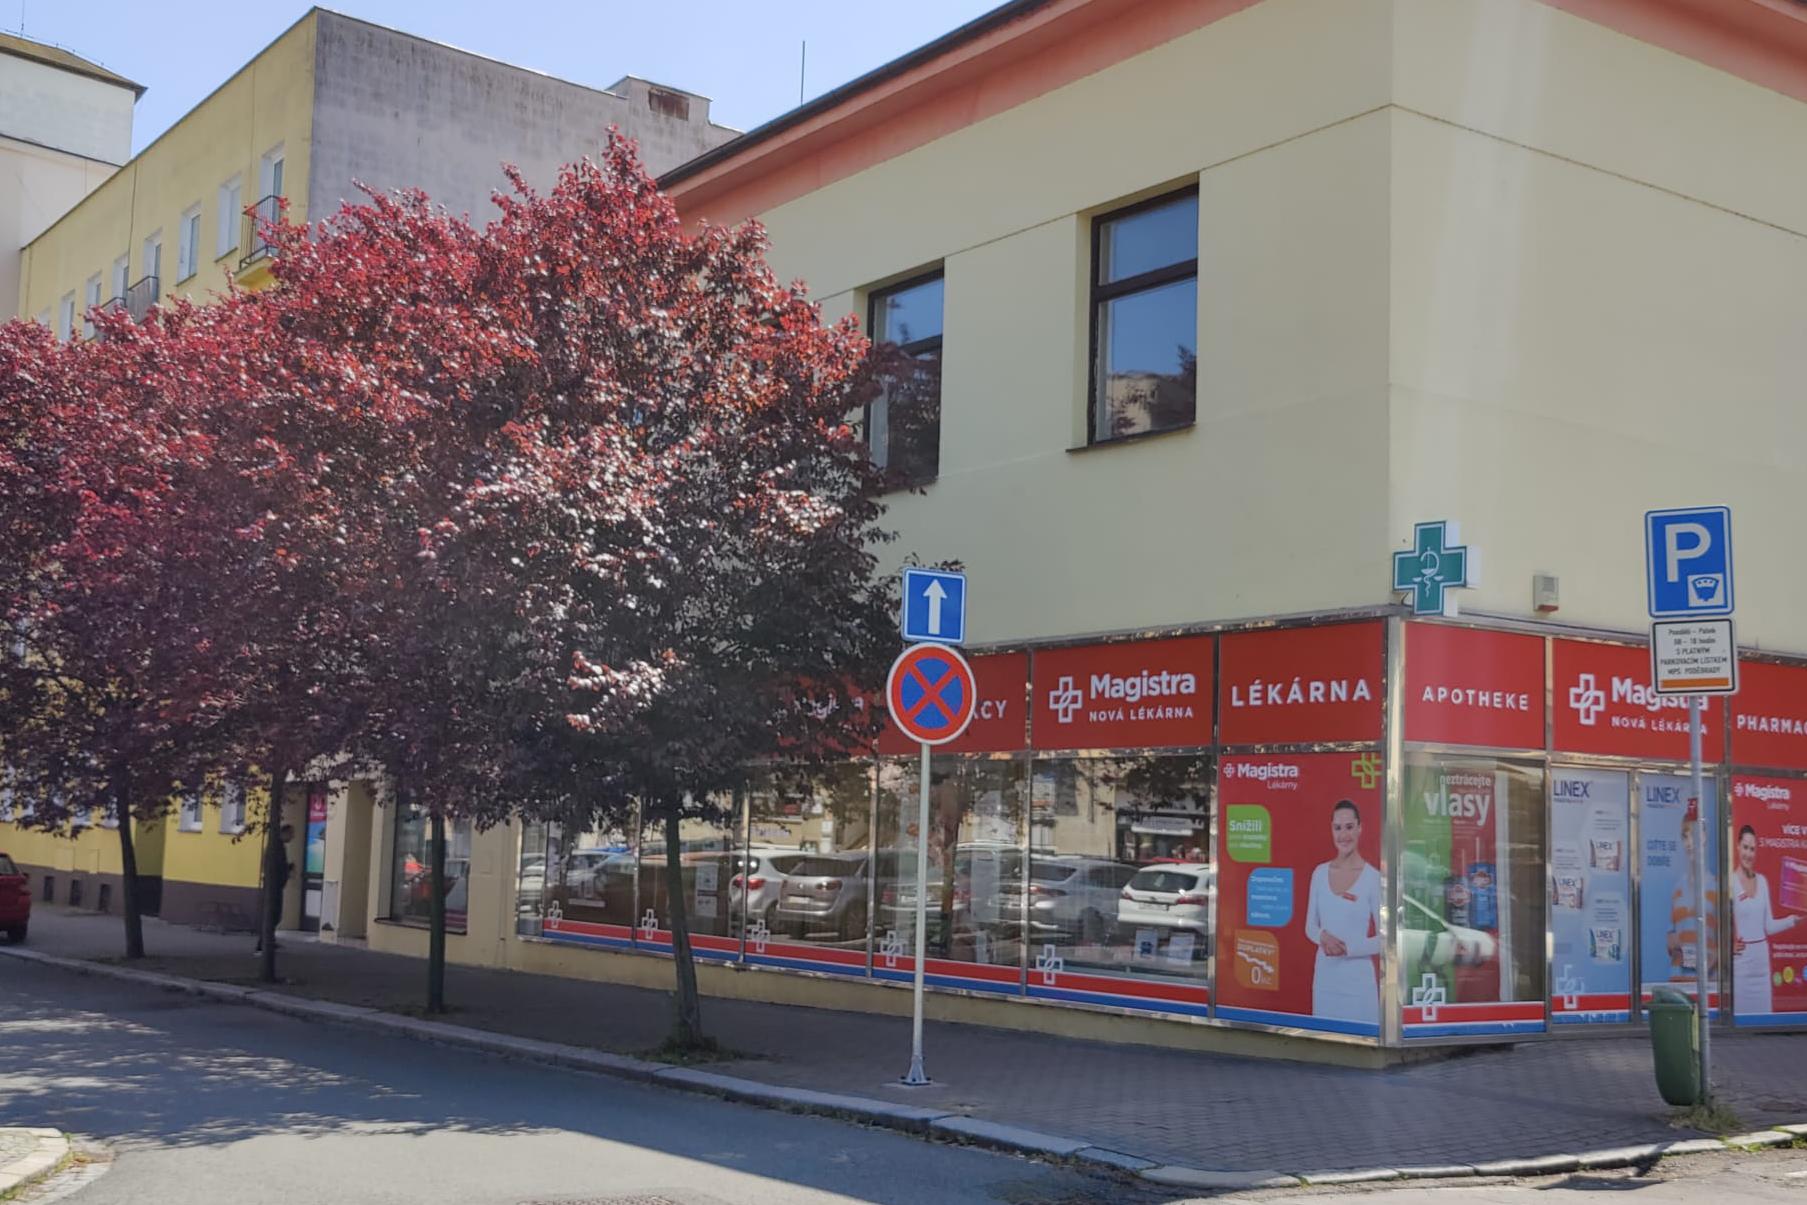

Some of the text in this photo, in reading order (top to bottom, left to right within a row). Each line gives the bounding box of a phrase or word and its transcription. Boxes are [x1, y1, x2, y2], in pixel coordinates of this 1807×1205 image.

[1665, 523, 1711, 582] P
[1090, 670, 1196, 702] Magistra
[1231, 677, 1371, 707] LÉKÁRNA
[1422, 685, 1530, 711] APOTHEKE
[1090, 705, 1194, 722] NOVÁ LÉKÁRNA
[1611, 715, 1708, 735] NOVÁ LÉKÁRA
[1237, 762, 1299, 780] Magistra
[1553, 780, 1590, 798] LINEX
[1646, 786, 1680, 803] LINEX
[1745, 783, 1791, 801] Magistra
[1423, 784, 1490, 826] vlasy
